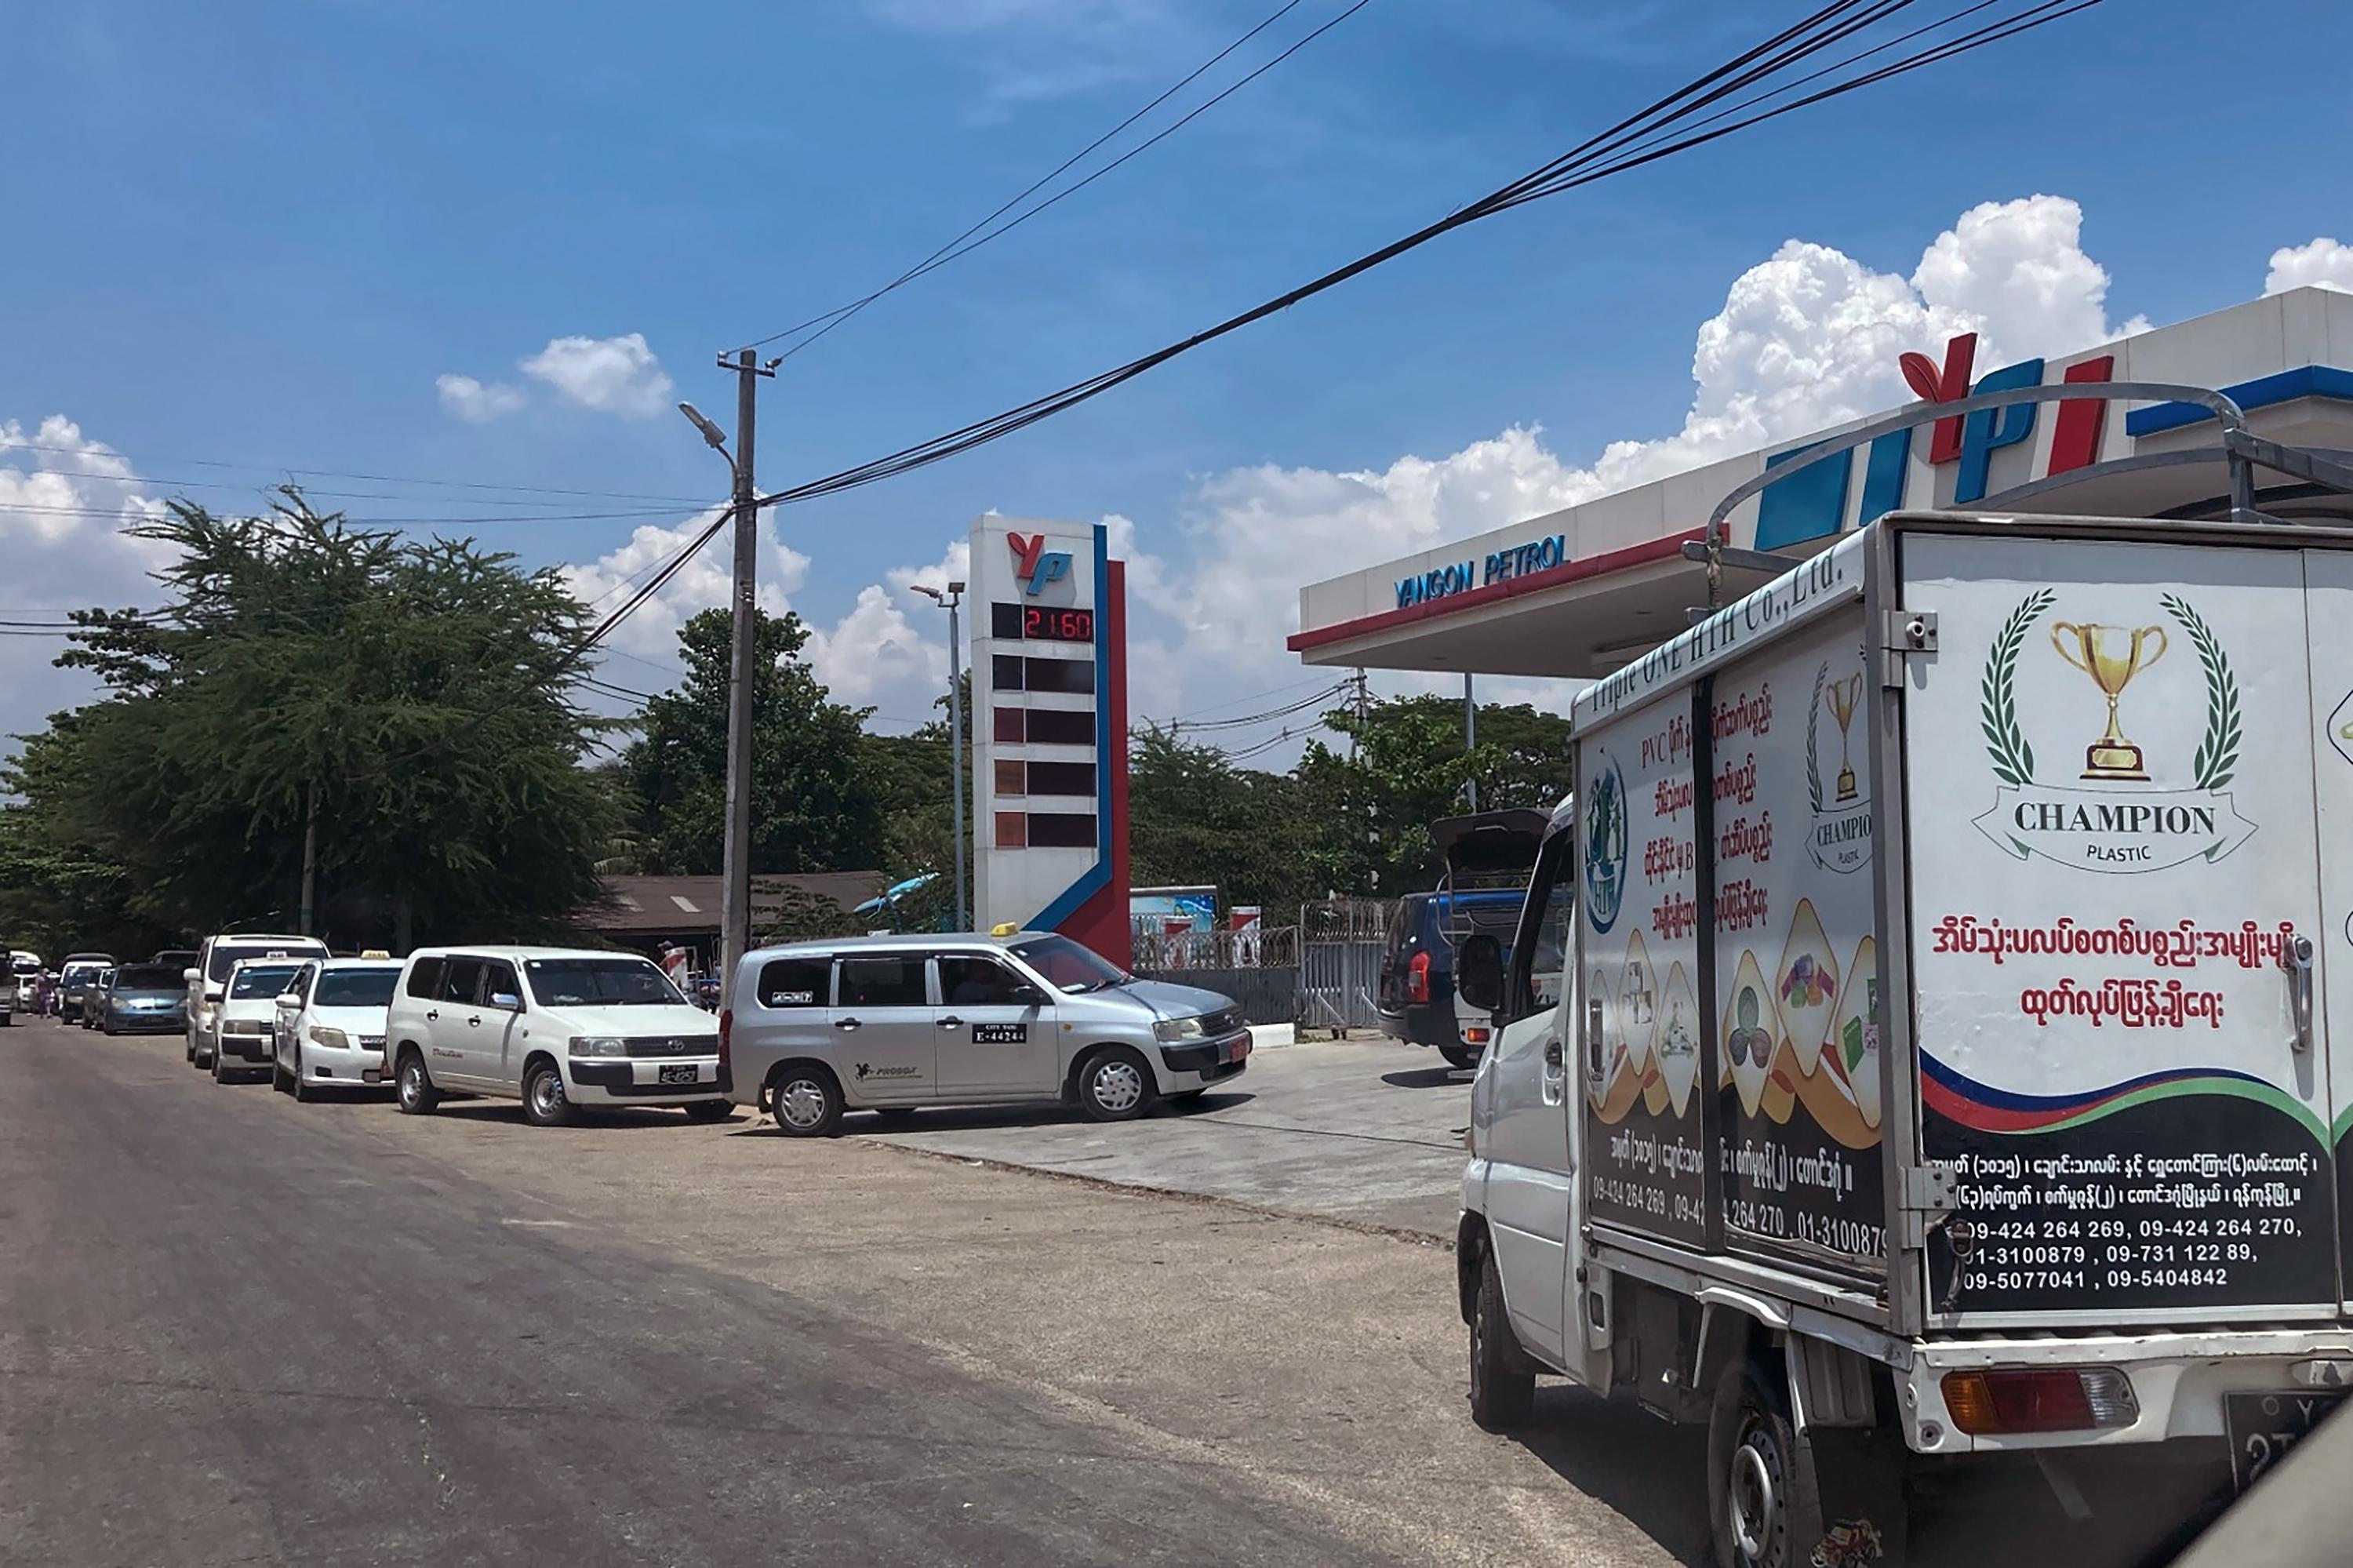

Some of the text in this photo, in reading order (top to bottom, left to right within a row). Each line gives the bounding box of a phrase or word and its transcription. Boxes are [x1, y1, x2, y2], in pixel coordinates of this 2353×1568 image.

[1395, 535, 1570, 609] YANGON PETROL
[1026, 610, 1091, 639] 2160
[1642, 638, 1682, 684] ONE
[1642, 731, 1667, 769] PVC
[1817, 813, 1871, 846] CHAMPIO
[2014, 802, 2216, 835] CHAMPION
[2086, 844, 2152, 862] PLASTIC
[1593, 1176, 1624, 1206] 09-424
[1626, 1182, 1644, 1209] 264
[1646, 1187, 1665, 1215] 269
[1732, 1199, 1755, 1229] 264
[1759, 1204, 1784, 1235] 270
[2043, 1221, 2080, 1238] 264
[2088, 1221, 2133, 1240] 269,
[2140, 1220, 2209, 1237] 09-424
[2216, 1219, 2253, 1236] 264
[2259, 1217, 2303, 1237] 270,
[2107, 1245, 2175, 1262] 09-731
[2184, 1244, 2220, 1261] 122
[2227, 1243, 2258, 1262] 89,
[1964, 1271, 2085, 1290] 09-5077041
[2108, 1268, 2228, 1287] 09-5404842
